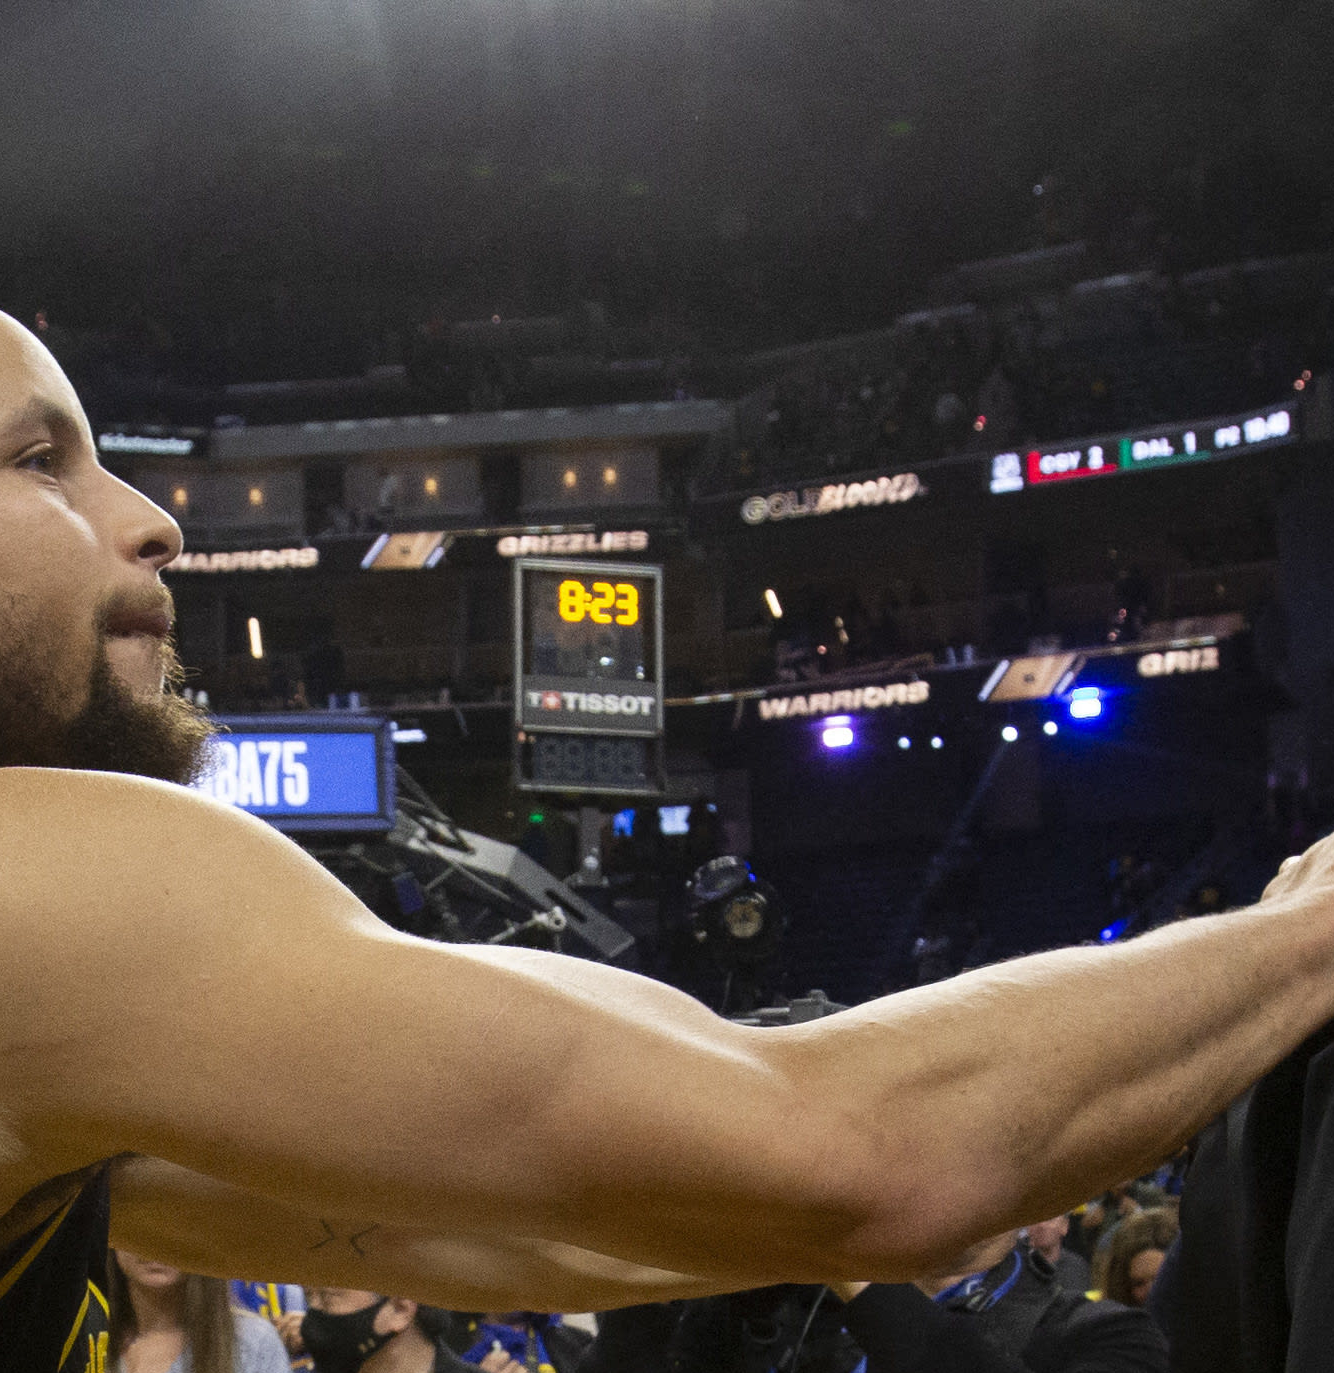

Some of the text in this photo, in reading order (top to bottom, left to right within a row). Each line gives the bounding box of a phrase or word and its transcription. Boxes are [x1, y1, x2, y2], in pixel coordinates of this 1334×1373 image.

[496, 530, 649, 557] GRIZZLIES
[559, 580, 639, 626] 8:23
[566, 692, 656, 716] TISSOT
[758, 680, 931, 721] WARRIORS
[209, 740, 310, 807] BA75
